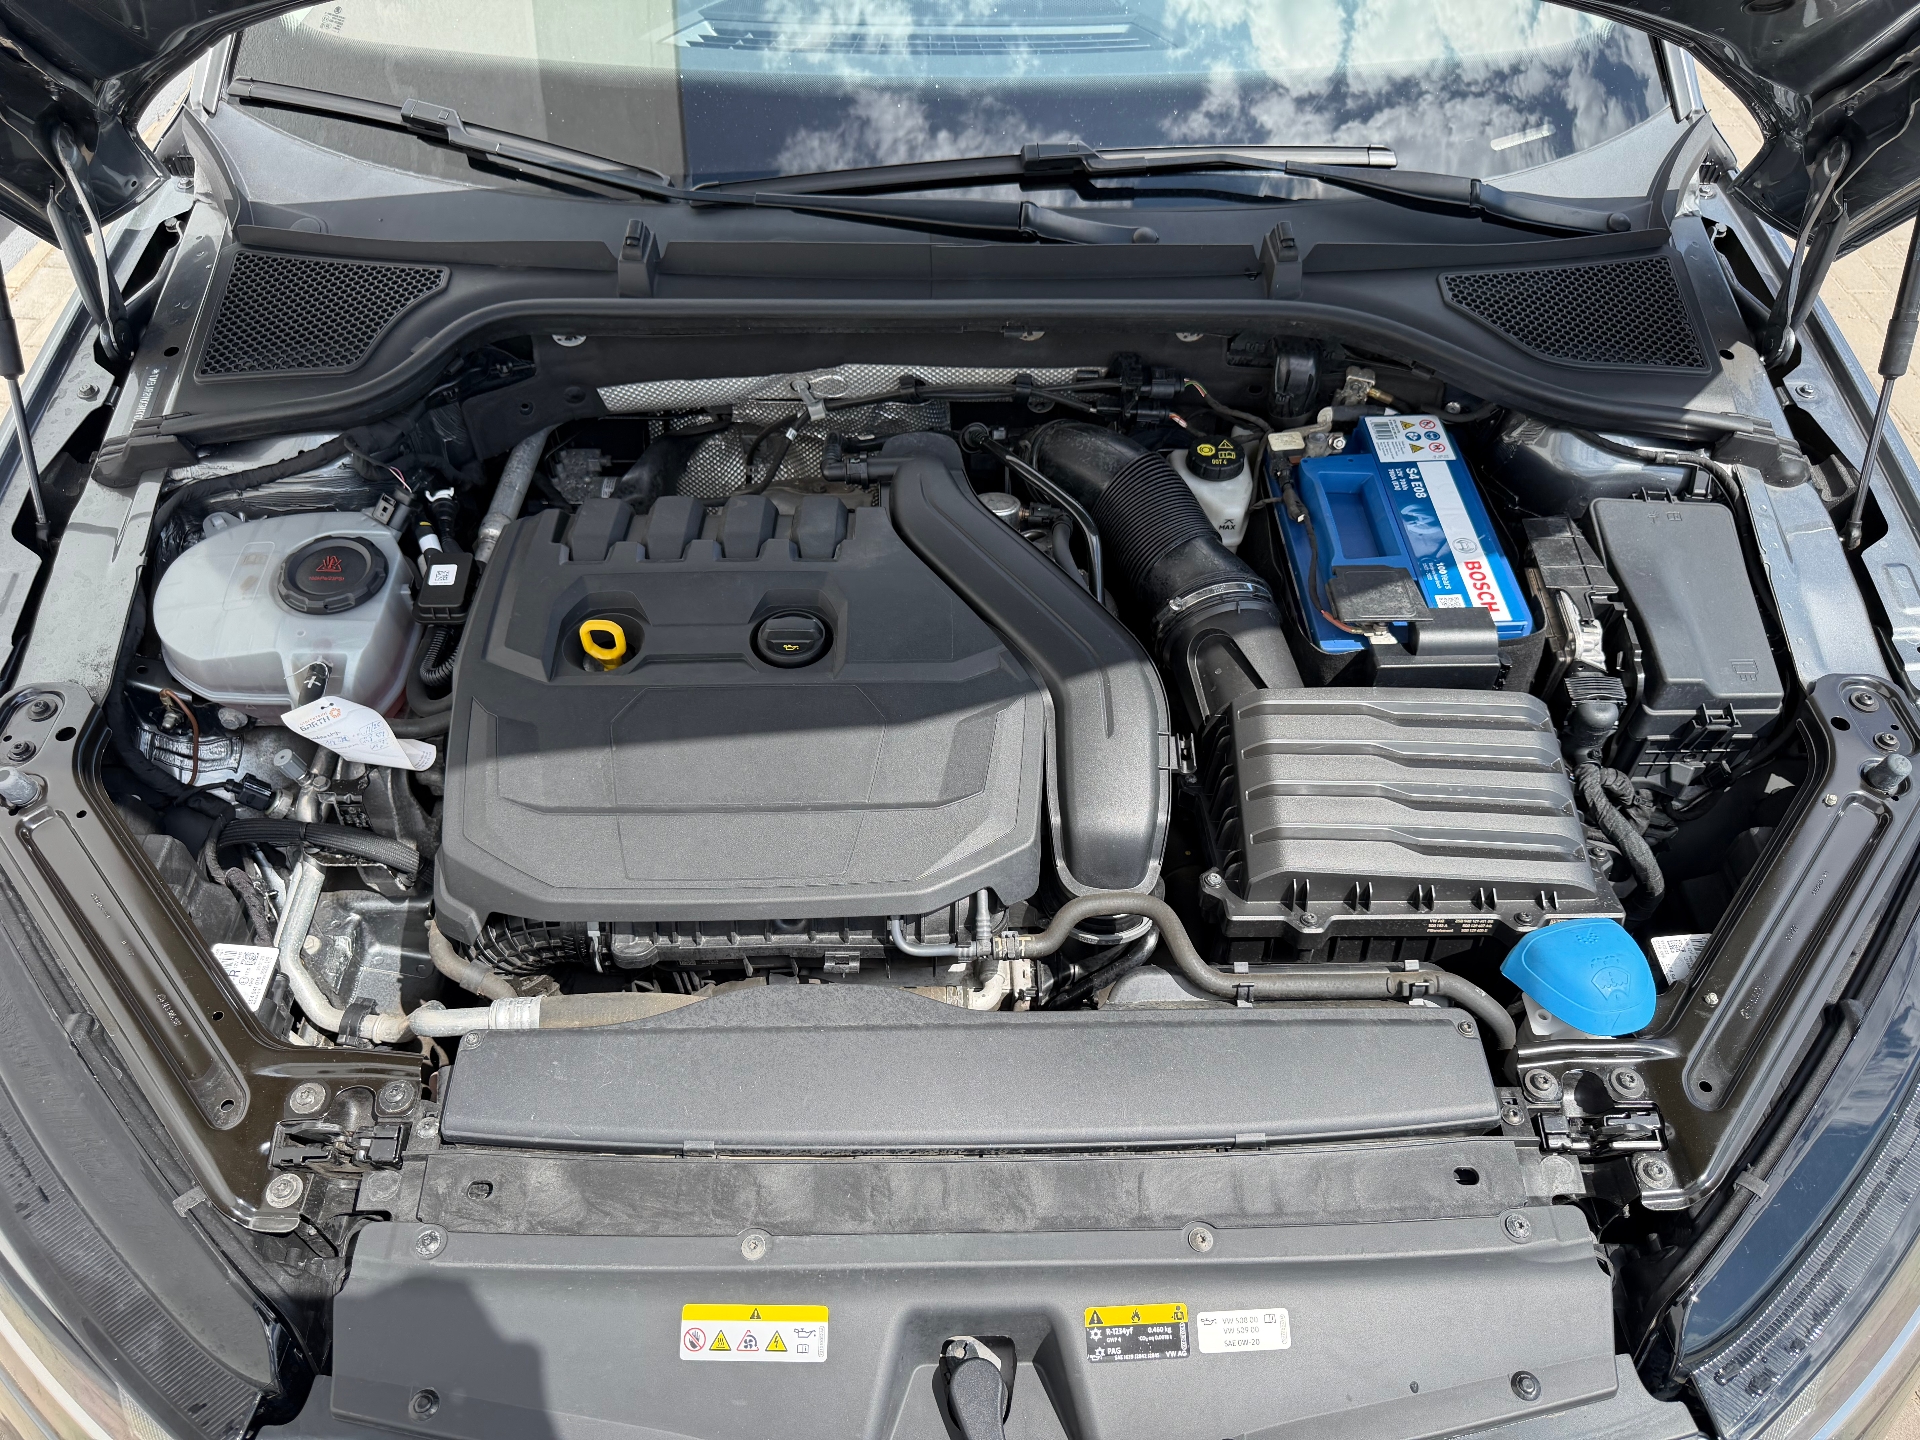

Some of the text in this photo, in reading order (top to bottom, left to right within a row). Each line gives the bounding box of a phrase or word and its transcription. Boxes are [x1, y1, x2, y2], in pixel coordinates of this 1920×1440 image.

[1406, 467, 1428, 499] S4 E08
[1436, 562, 1452, 590] 100 Years
[1463, 560, 1501, 613] BOSCH
[1105, 1326, 1134, 1337] R-1234yf
[1164, 1325, 1172, 1334] kg
[1223, 1327, 1235, 1335] VW
[1223, 1338, 1260, 1347] SAE 0W-20
[1107, 1347, 1122, 1355] PAG
